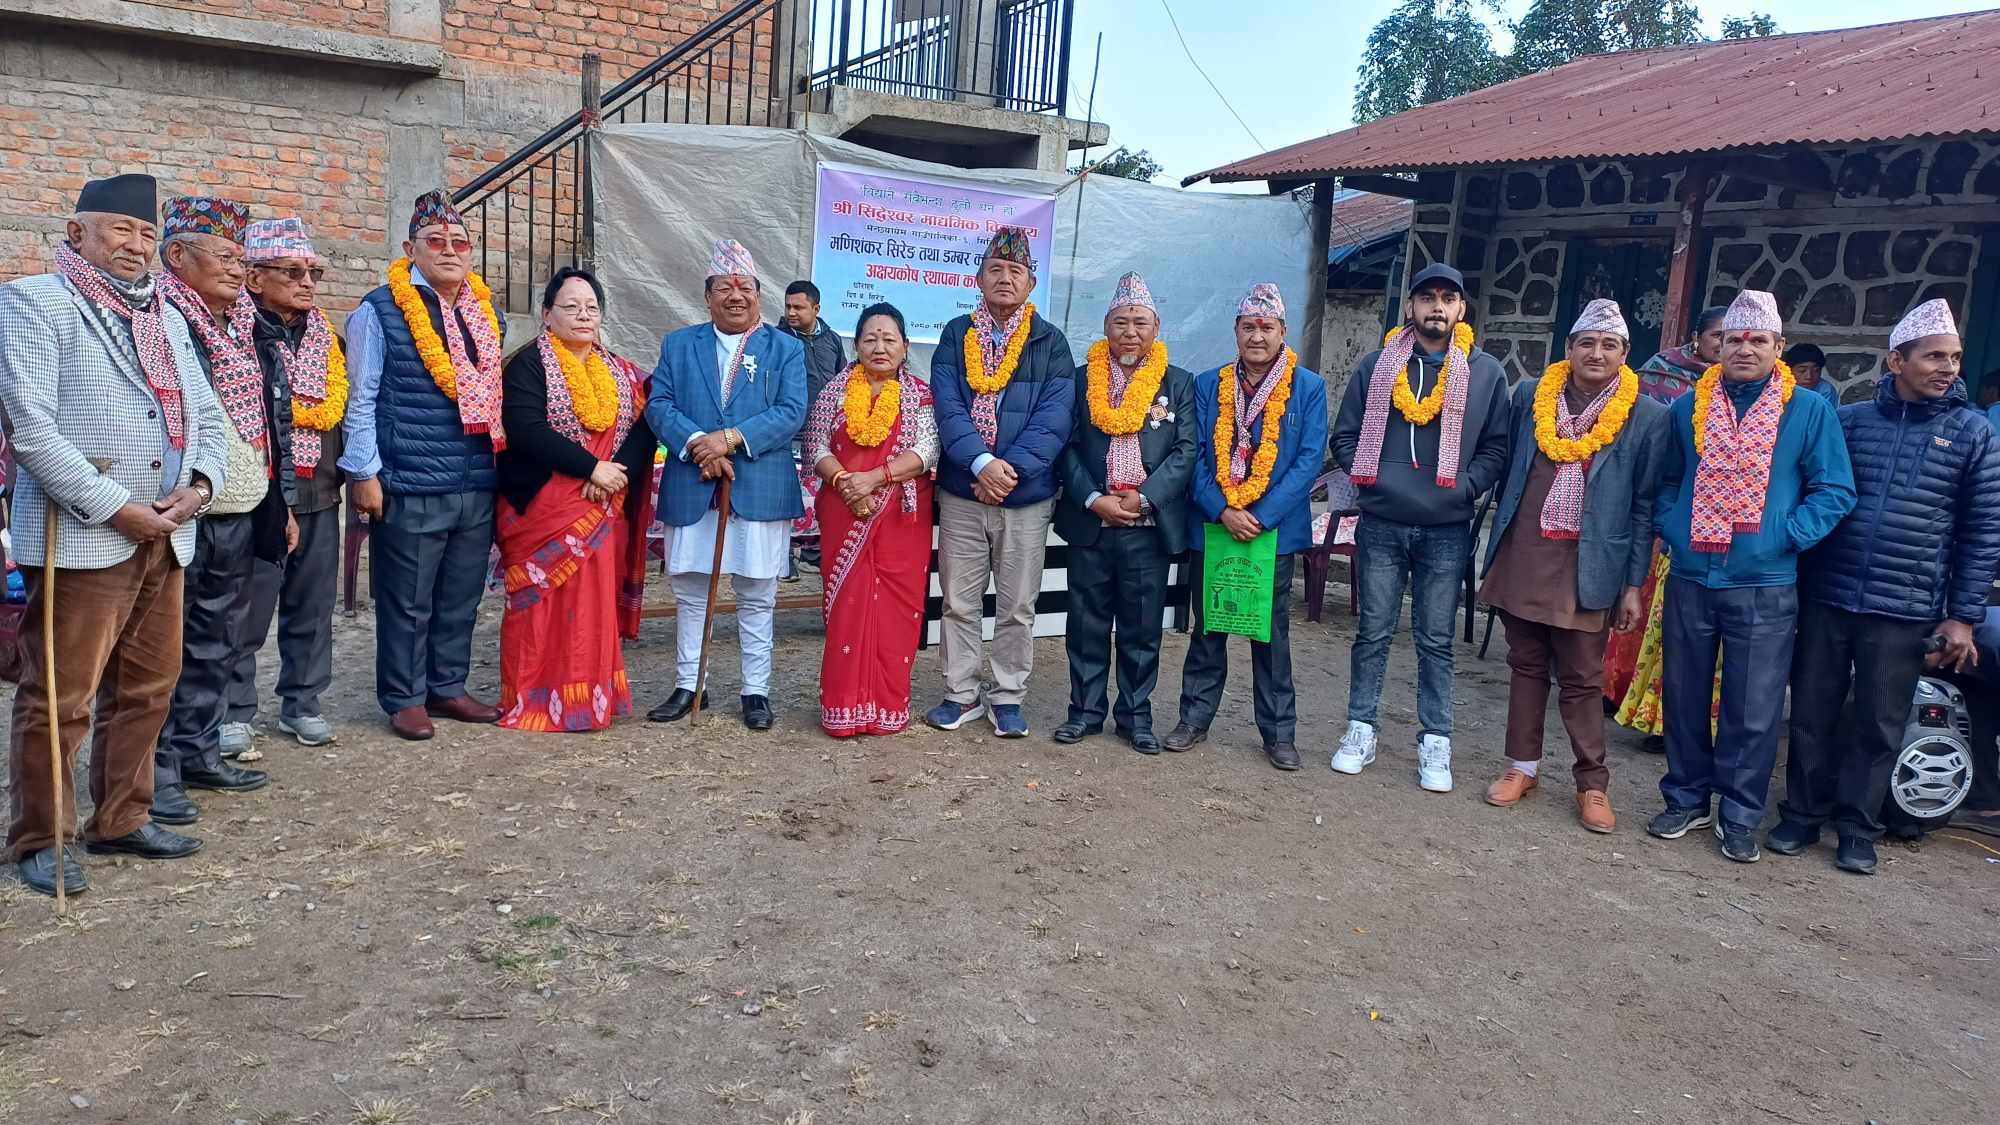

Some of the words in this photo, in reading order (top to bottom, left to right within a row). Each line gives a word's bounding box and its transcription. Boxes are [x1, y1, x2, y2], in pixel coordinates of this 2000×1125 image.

[832, 200, 852, 215] श्री
[920, 214, 980, 232] माध्यमिक
[830, 232, 884, 257] मणिशंकर
[919, 246, 941, 263] तथा
[942, 248, 972, 267] डम्बर
[865, 262, 921, 283] अक्षयकोष
[923, 269, 961, 287] स्थापना
